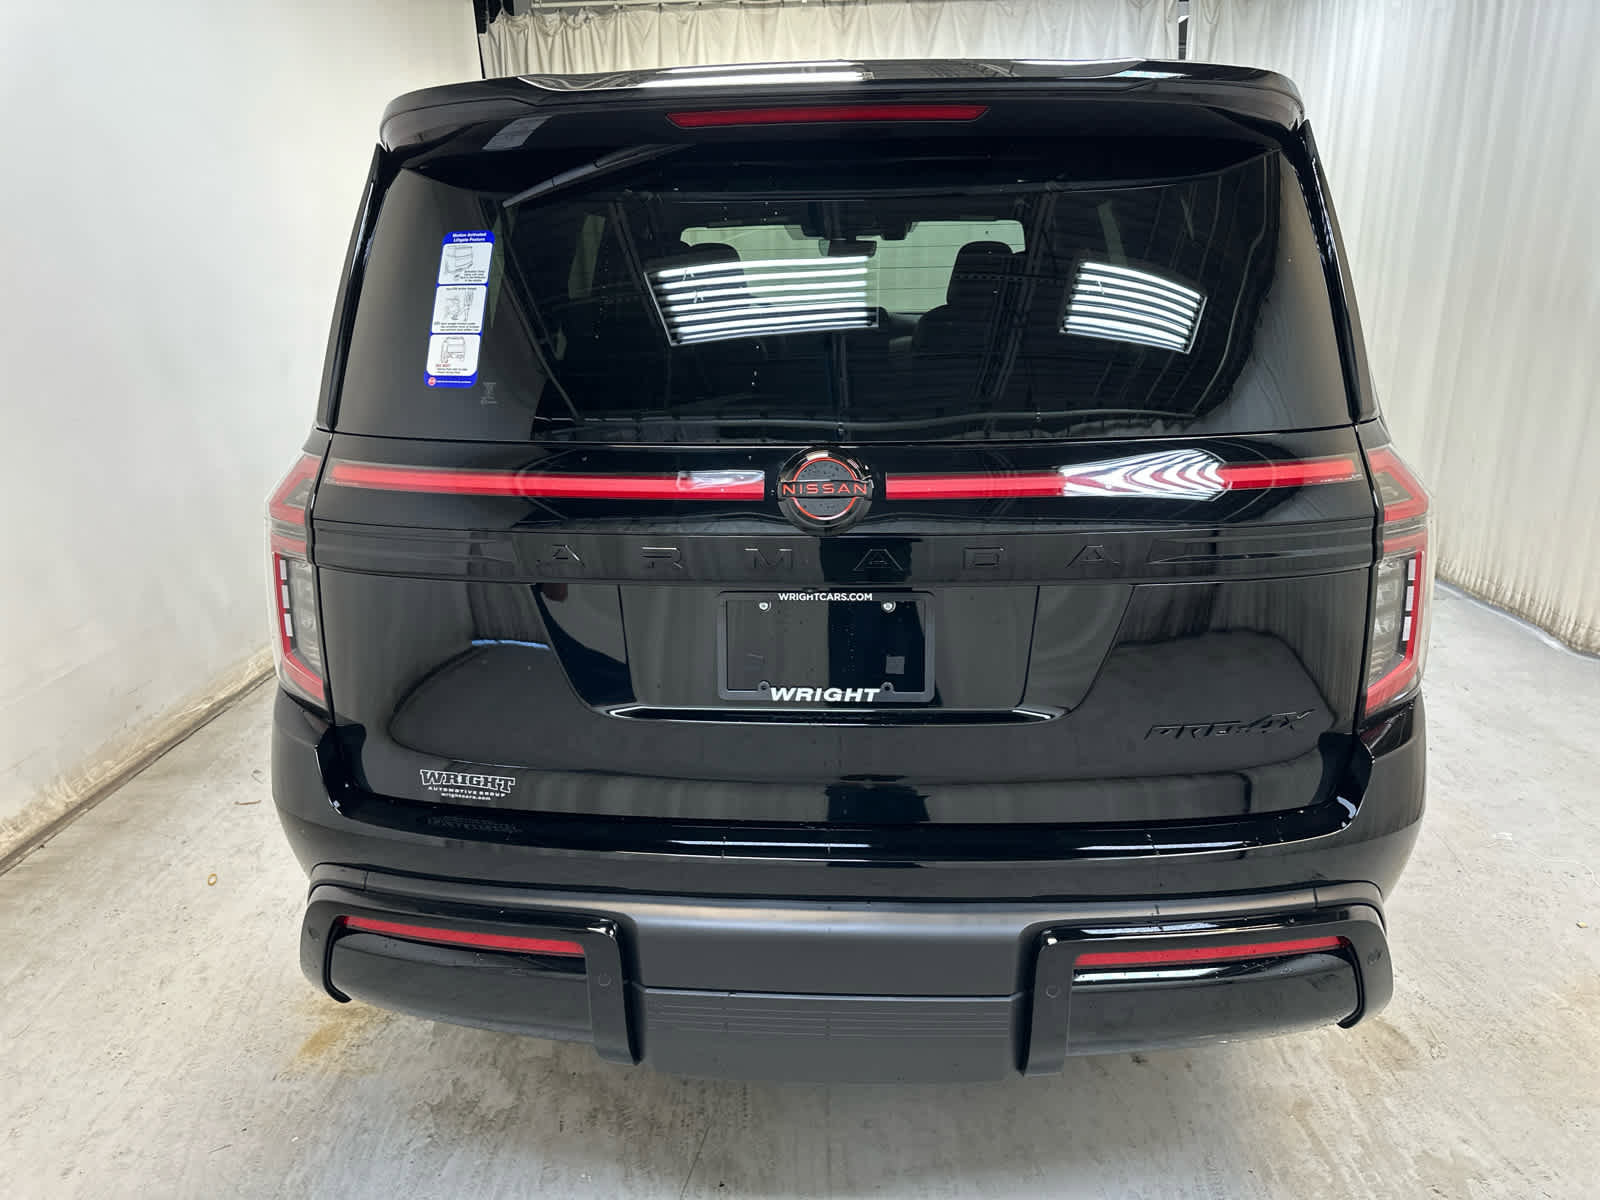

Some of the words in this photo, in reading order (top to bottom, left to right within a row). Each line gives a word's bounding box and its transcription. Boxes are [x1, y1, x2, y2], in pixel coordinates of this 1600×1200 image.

[782, 483, 868, 495] NISSAN
[535, 544, 1121, 571] ARMADA
[777, 592, 873, 601] WRIGHTCARS.COM
[770, 687, 880, 702] WRIGHT
[419, 769, 516, 794] WRIGHT
[428, 786, 477, 795] AUTOMOTIVE
[478, 790, 506, 798] GROUP
